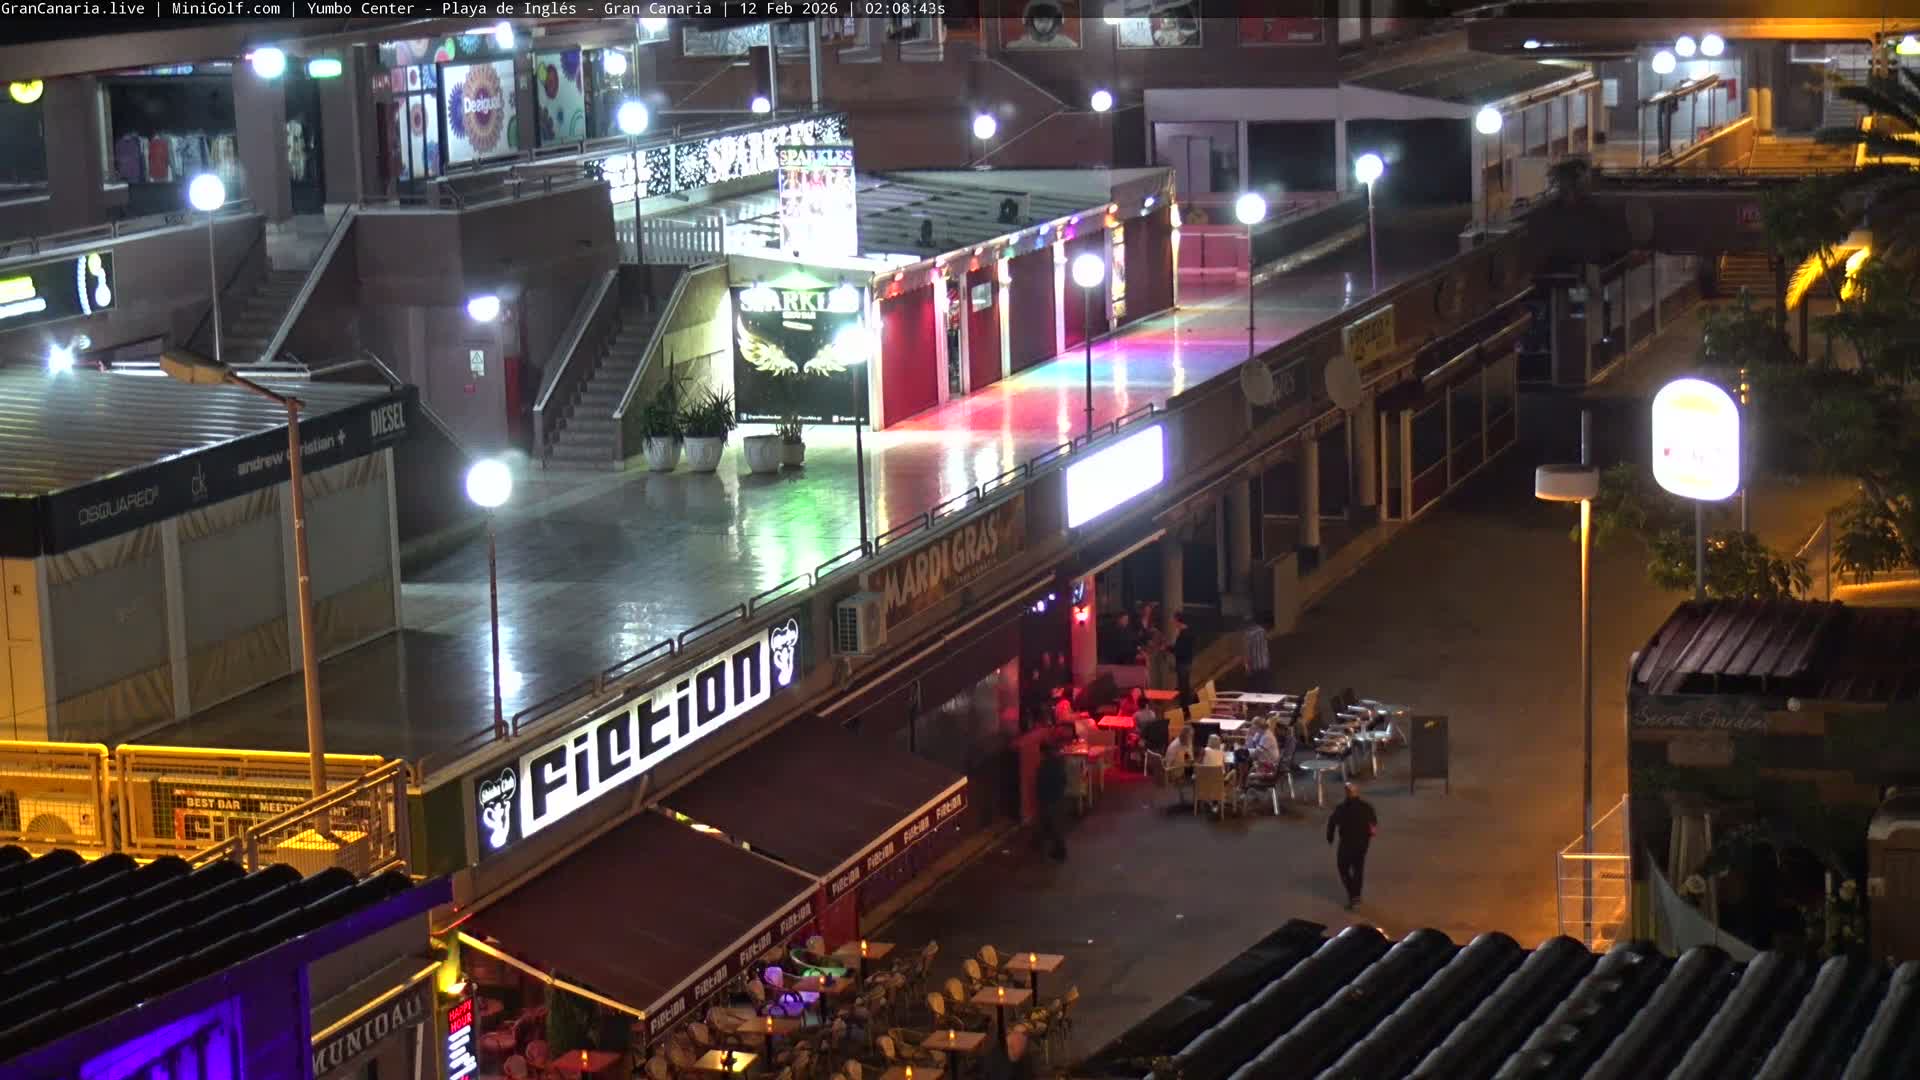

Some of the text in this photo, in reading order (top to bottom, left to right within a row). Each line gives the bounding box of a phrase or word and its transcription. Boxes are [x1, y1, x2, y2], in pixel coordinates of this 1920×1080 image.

[779, 149, 853, 163] SPARKLES
[370, 402, 406, 437] DIESEL
[237, 436, 335, 475] andrew cristian
[882, 540, 949, 613] MARDI
[952, 512, 999, 573] GRAS
[186, 797, 214, 808] BEST
[217, 800, 241, 810] BAR
[449, 1000, 473, 1021] HAPPY
[450, 1013, 473, 1033] HOUR
